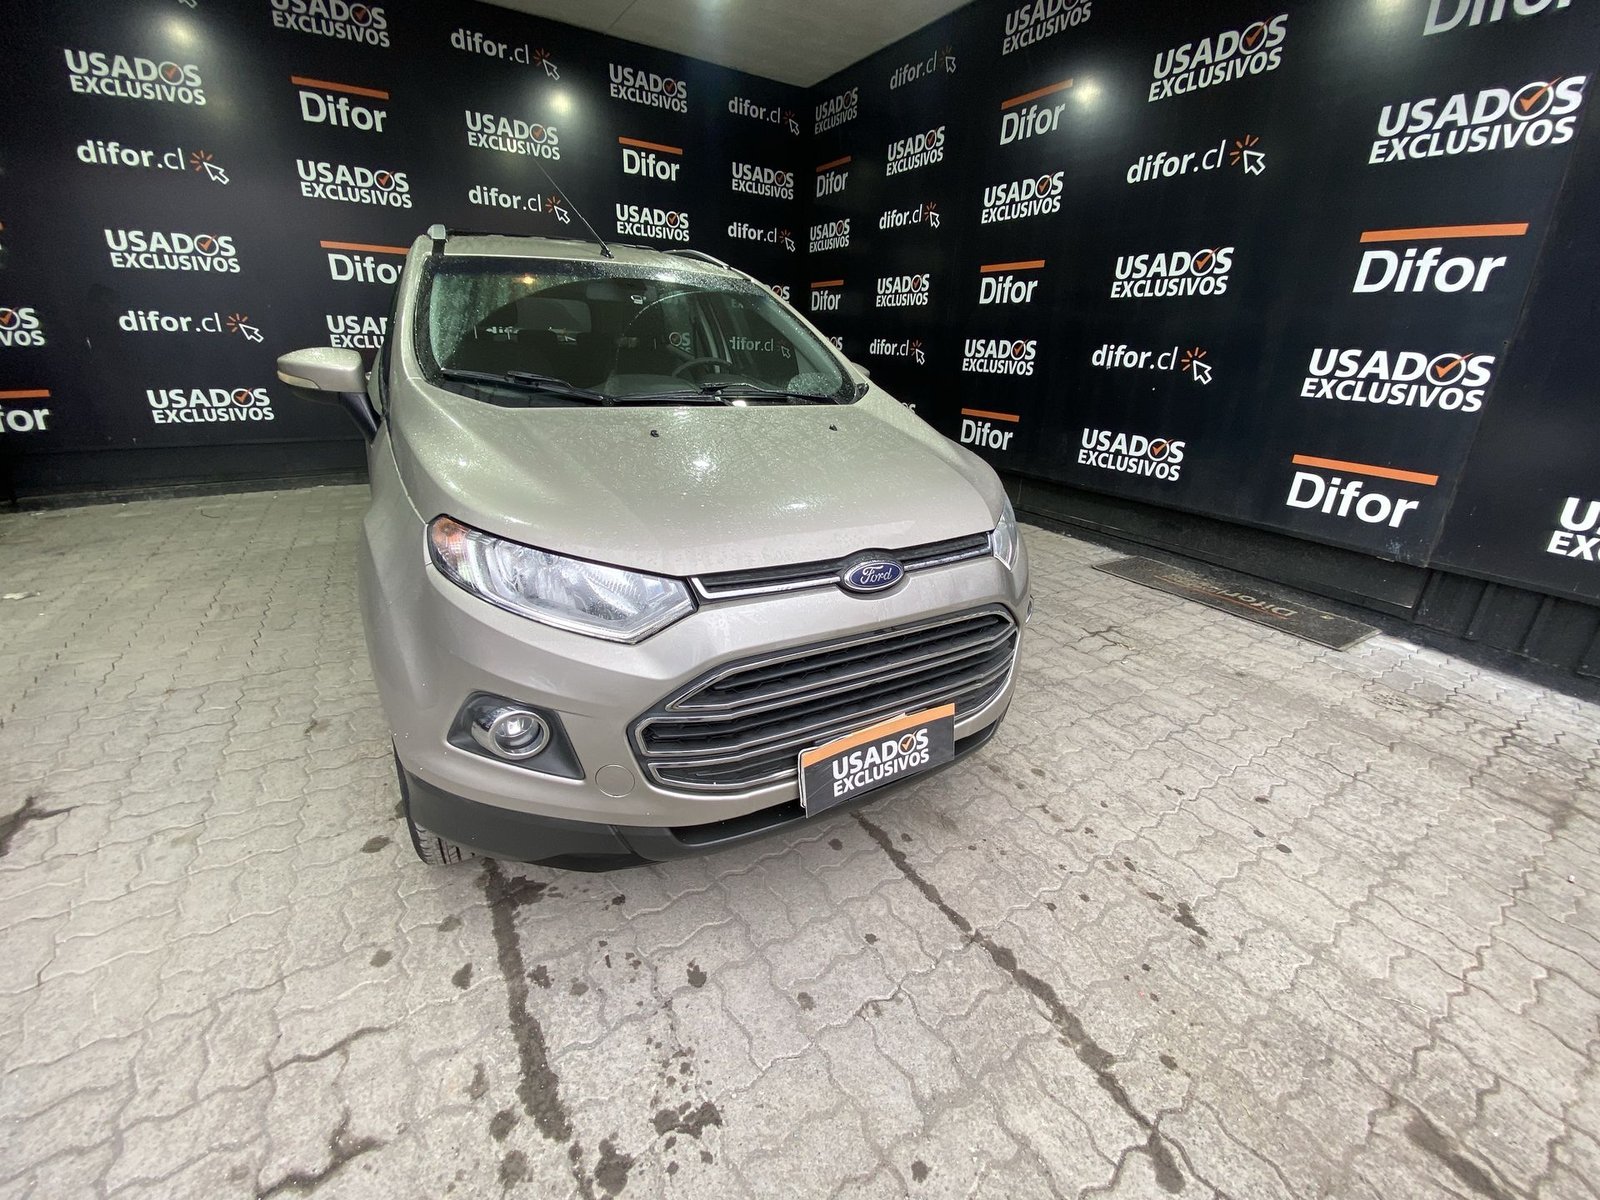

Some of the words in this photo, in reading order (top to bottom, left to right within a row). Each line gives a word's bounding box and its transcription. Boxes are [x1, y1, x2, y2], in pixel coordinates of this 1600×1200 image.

[272, 10, 391, 48] EXCLUSIVOS
[1002, 1, 1092, 55] EXCLUSIVOS
[1005, 0, 1089, 36] USAD
[451, 28, 530, 65] difor.cl
[1153, 13, 1289, 80] USADOS
[64, 48, 202, 88] USADOS
[609, 63, 688, 99] USADOS
[889, 50, 937, 90] difor.cl
[1147, 46, 1283, 103] EXCLUSIVOS
[69, 74, 206, 106] EXCLUSIVOS
[610, 84, 688, 113] EXCLUSIVOS
[815, 87, 858, 121] USADOS
[299, 90, 387, 133] Difor
[728, 97, 781, 124] difor.cl
[814, 105, 858, 135] EXCLUSIVOS
[1377, 75, 1587, 138] USADOS
[465, 110, 559, 145] USADOS
[1000, 103, 1066, 146] Difor
[76, 140, 185, 171] difor.cl
[467, 131, 561, 161] EXCLUSIVOS
[887, 126, 945, 163] USADOS
[1368, 116, 1577, 165] EXCLUSIVOS
[296, 159, 410, 193] USADOS
[622, 148, 680, 181] Difor
[731, 162, 794, 188] USADOS
[886, 148, 944, 177] EXCLUSIVOS
[1126, 140, 1227, 184] difor.cl
[300, 182, 413, 209] EXCLUSIVOS
[468, 185, 542, 212] difor.cl
[731, 179, 794, 200] EXCLUSIVOS
[816, 171, 848, 198] Difor
[983, 171, 1065, 208] USADOS
[615, 203, 689, 229] USADOS
[879, 203, 923, 230] difor.cl
[980, 195, 1062, 225] EXCLUSIVOS
[104, 229, 236, 257] USADOS
[616, 222, 690, 242] EXCLUSIVOS
[727, 222, 778, 243] difor.cl
[809, 234, 850, 253] EXCLUSIVOS
[810, 218, 850, 241] USADOS
[110, 251, 241, 274] EXCLUSIVOS
[327, 253, 402, 284] Difo
[1115, 247, 1235, 281] USADOS
[1352, 246, 1508, 294] Difor
[876, 288, 929, 308] EXCLUSIVOS
[877, 274, 930, 295] USADOS
[979, 275, 1039, 304] Difor
[1110, 275, 1228, 299] EXCLUSIVOS
[811, 290, 841, 311] Difor
[119, 310, 222, 333] difor.cl
[869, 339, 909, 357] difor.cl
[963, 338, 1037, 362] USADOS
[1091, 344, 1178, 372] difor.cl
[962, 357, 1035, 376] EXCLUSIVOS
[1308, 347, 1496, 388] USADOS
[146, 388, 271, 408] USADOS
[1300, 377, 1486, 413] EXCLUSIVOS
[151, 407, 275, 424] EXCLUSIVOS
[960, 418, 1014, 451] Difor
[1081, 427, 1186, 465] USADOS
[1077, 448, 1181, 482] EXCLUSIVOS
[1285, 470, 1420, 529] Difor
[860, 565, 893, 585] Ford
[832, 728, 929, 780] USADOS
[833, 750, 930, 798] EXCLUSIVOS
